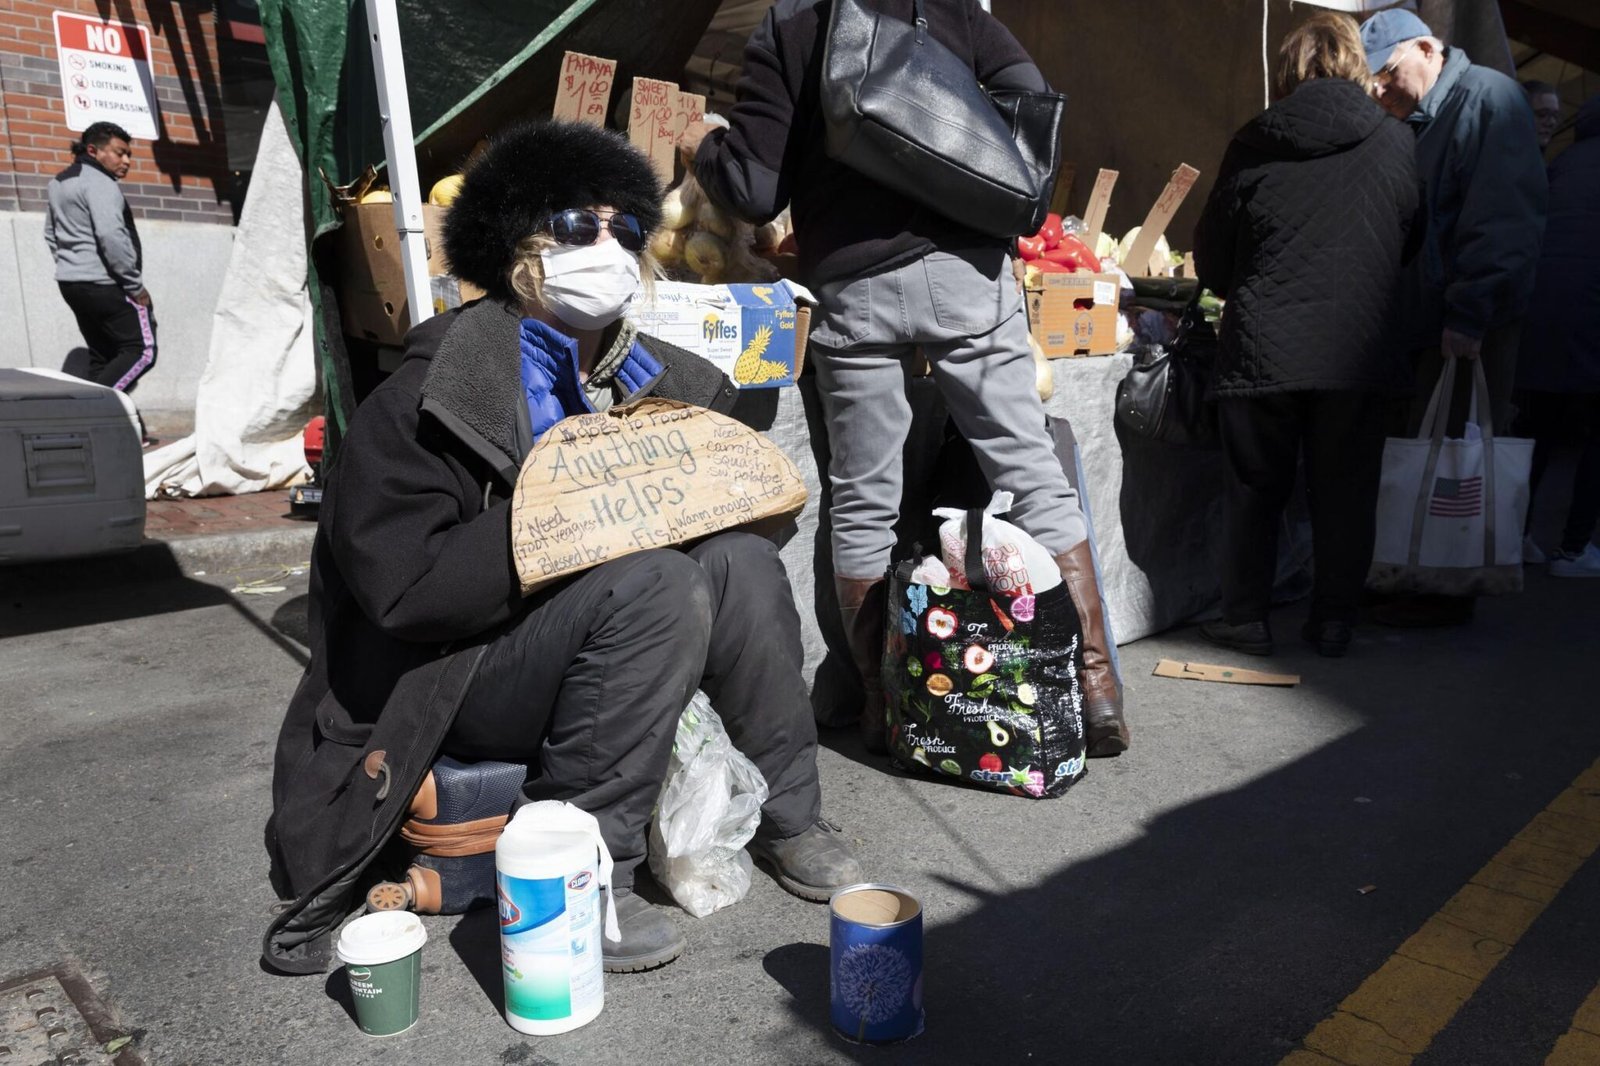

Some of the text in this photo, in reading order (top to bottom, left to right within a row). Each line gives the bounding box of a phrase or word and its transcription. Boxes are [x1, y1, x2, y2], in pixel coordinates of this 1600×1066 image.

[85, 24, 122, 54] NO
[89, 60, 127, 73] SMOKING
[566, 54, 613, 80] PAPAYA
[91, 80, 133, 93] LOITERING
[637, 80, 671, 95] SWEET
[94, 99, 150, 114] TRESPASSING
[634, 92, 669, 107] ONION
[657, 126, 674, 144] Bag
[703, 319, 738, 343] fyffes
[780, 321, 795, 330] Gold
[623, 416, 643, 431] to
[714, 427, 738, 439] Need
[548, 429, 697, 487] Anything
[591, 476, 686, 528] Helps
[713, 491, 759, 516] enough
[527, 505, 571, 538] Need
[537, 546, 583, 575] Blessed
[944, 692, 992, 715] Fresh
[903, 723, 945, 746] Fresh
[923, 744, 957, 754] PRODUCE
